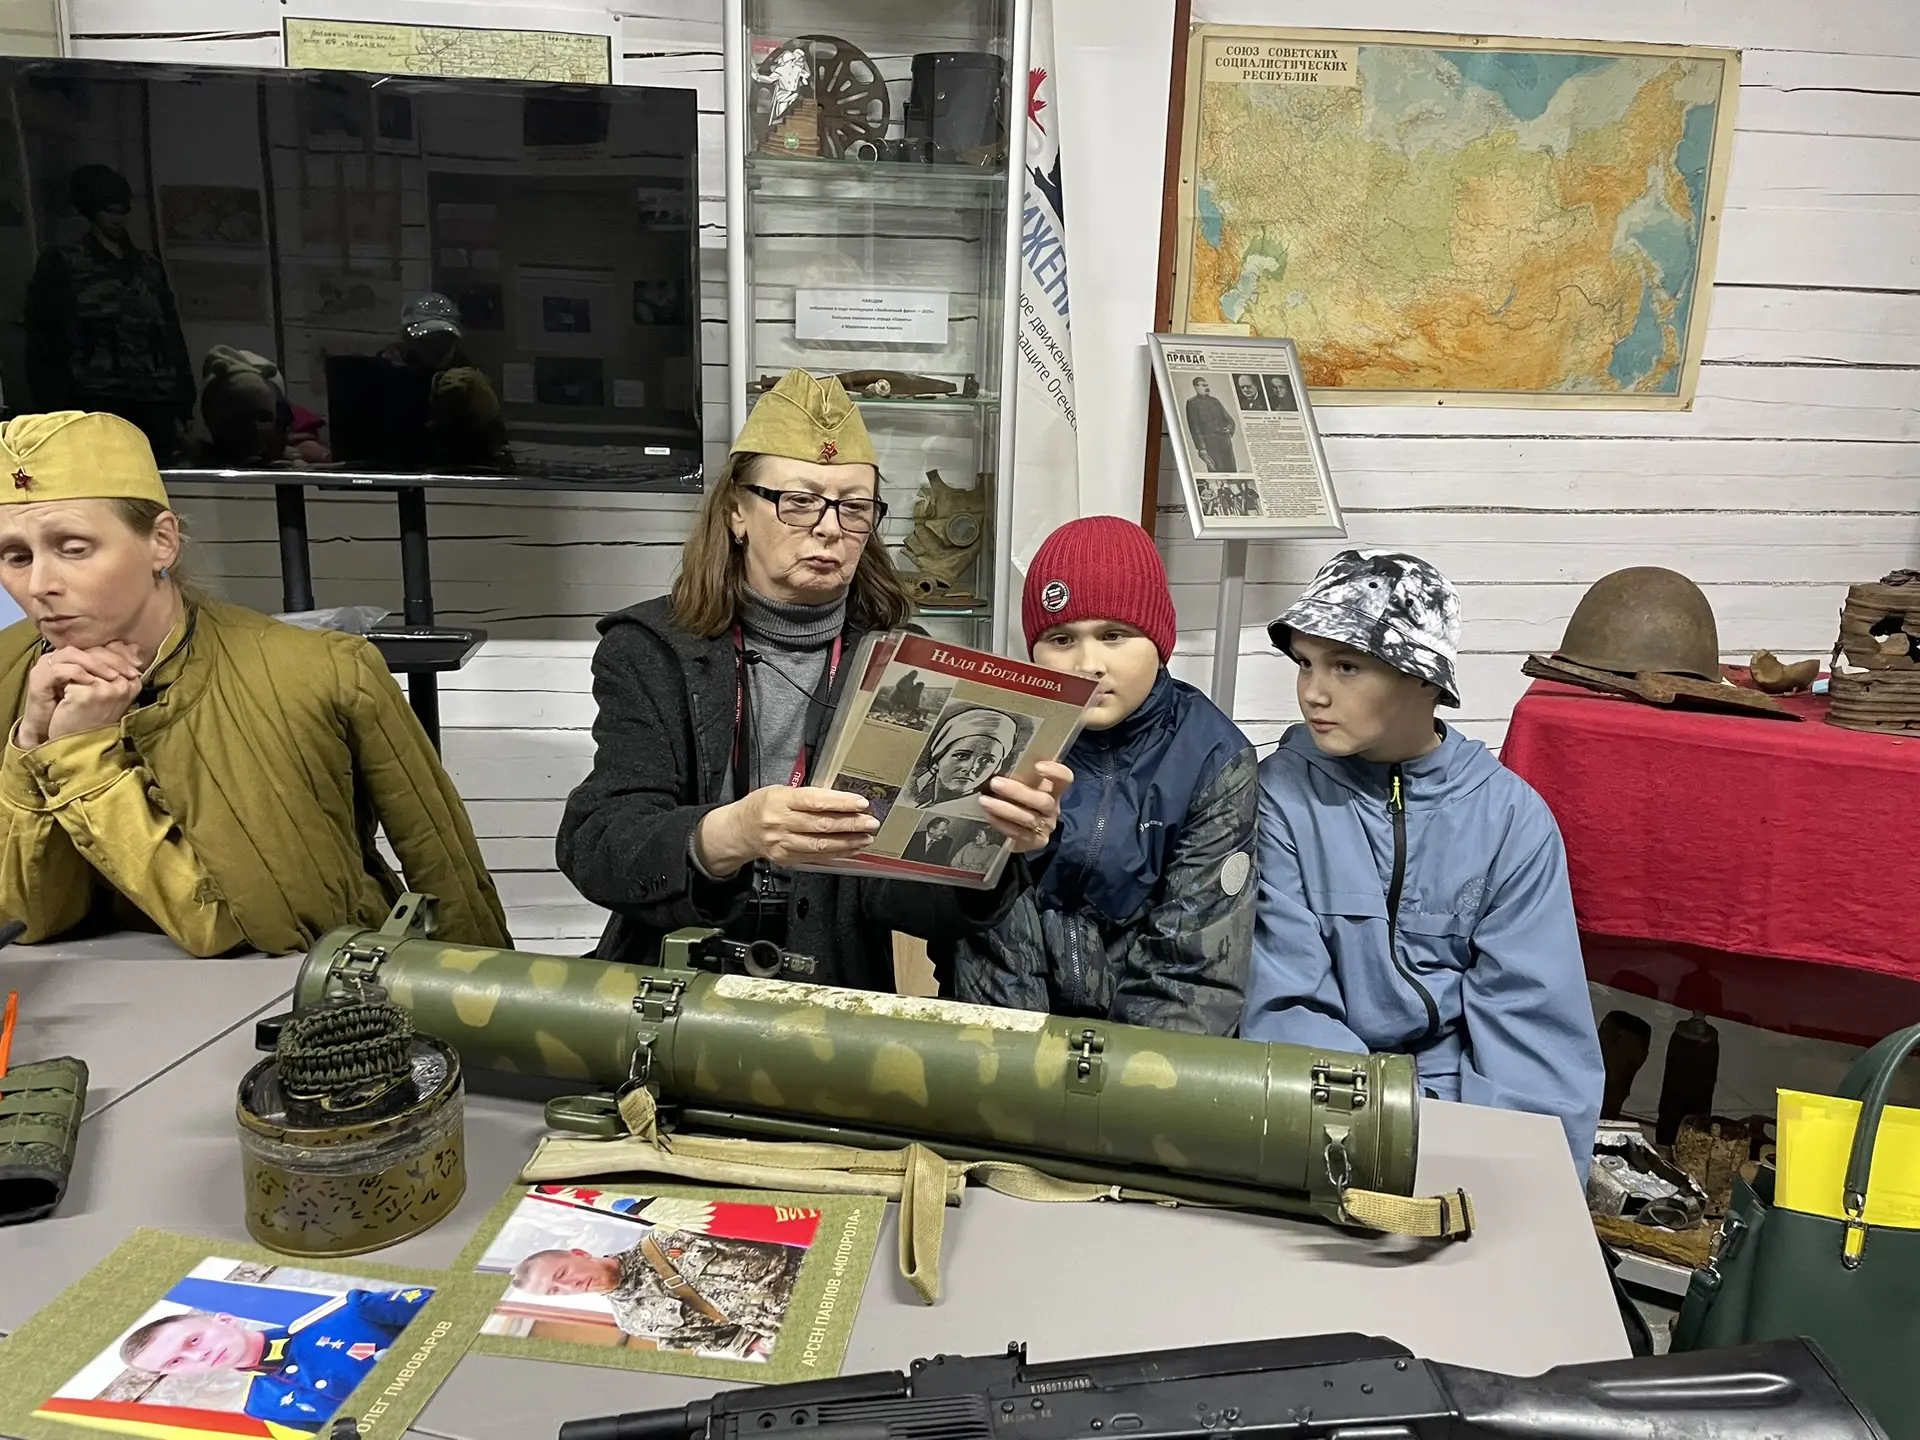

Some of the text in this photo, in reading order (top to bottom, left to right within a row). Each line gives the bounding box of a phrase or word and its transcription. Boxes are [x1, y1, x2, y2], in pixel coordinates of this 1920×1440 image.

[1215, 57, 1348, 71] СОЦИАЛИСТИЧЕСКИХ
[1226, 45, 1339, 59] СОЮЗ СОВЕТСКИХ
[1242, 70, 1319, 82] РЕСПУБЛИК
[1028, 316, 1075, 384] движение
[1166, 353, 1206, 364] ПРАВДА
[1047, 378, 1078, 431] Отечес
[801, 1208, 861, 1367] АРСЕН ПАВЛОВ «МОТОРОЛА»
[356, 1320, 453, 1433] ОЛЕГ ПИВОВАРОВ
